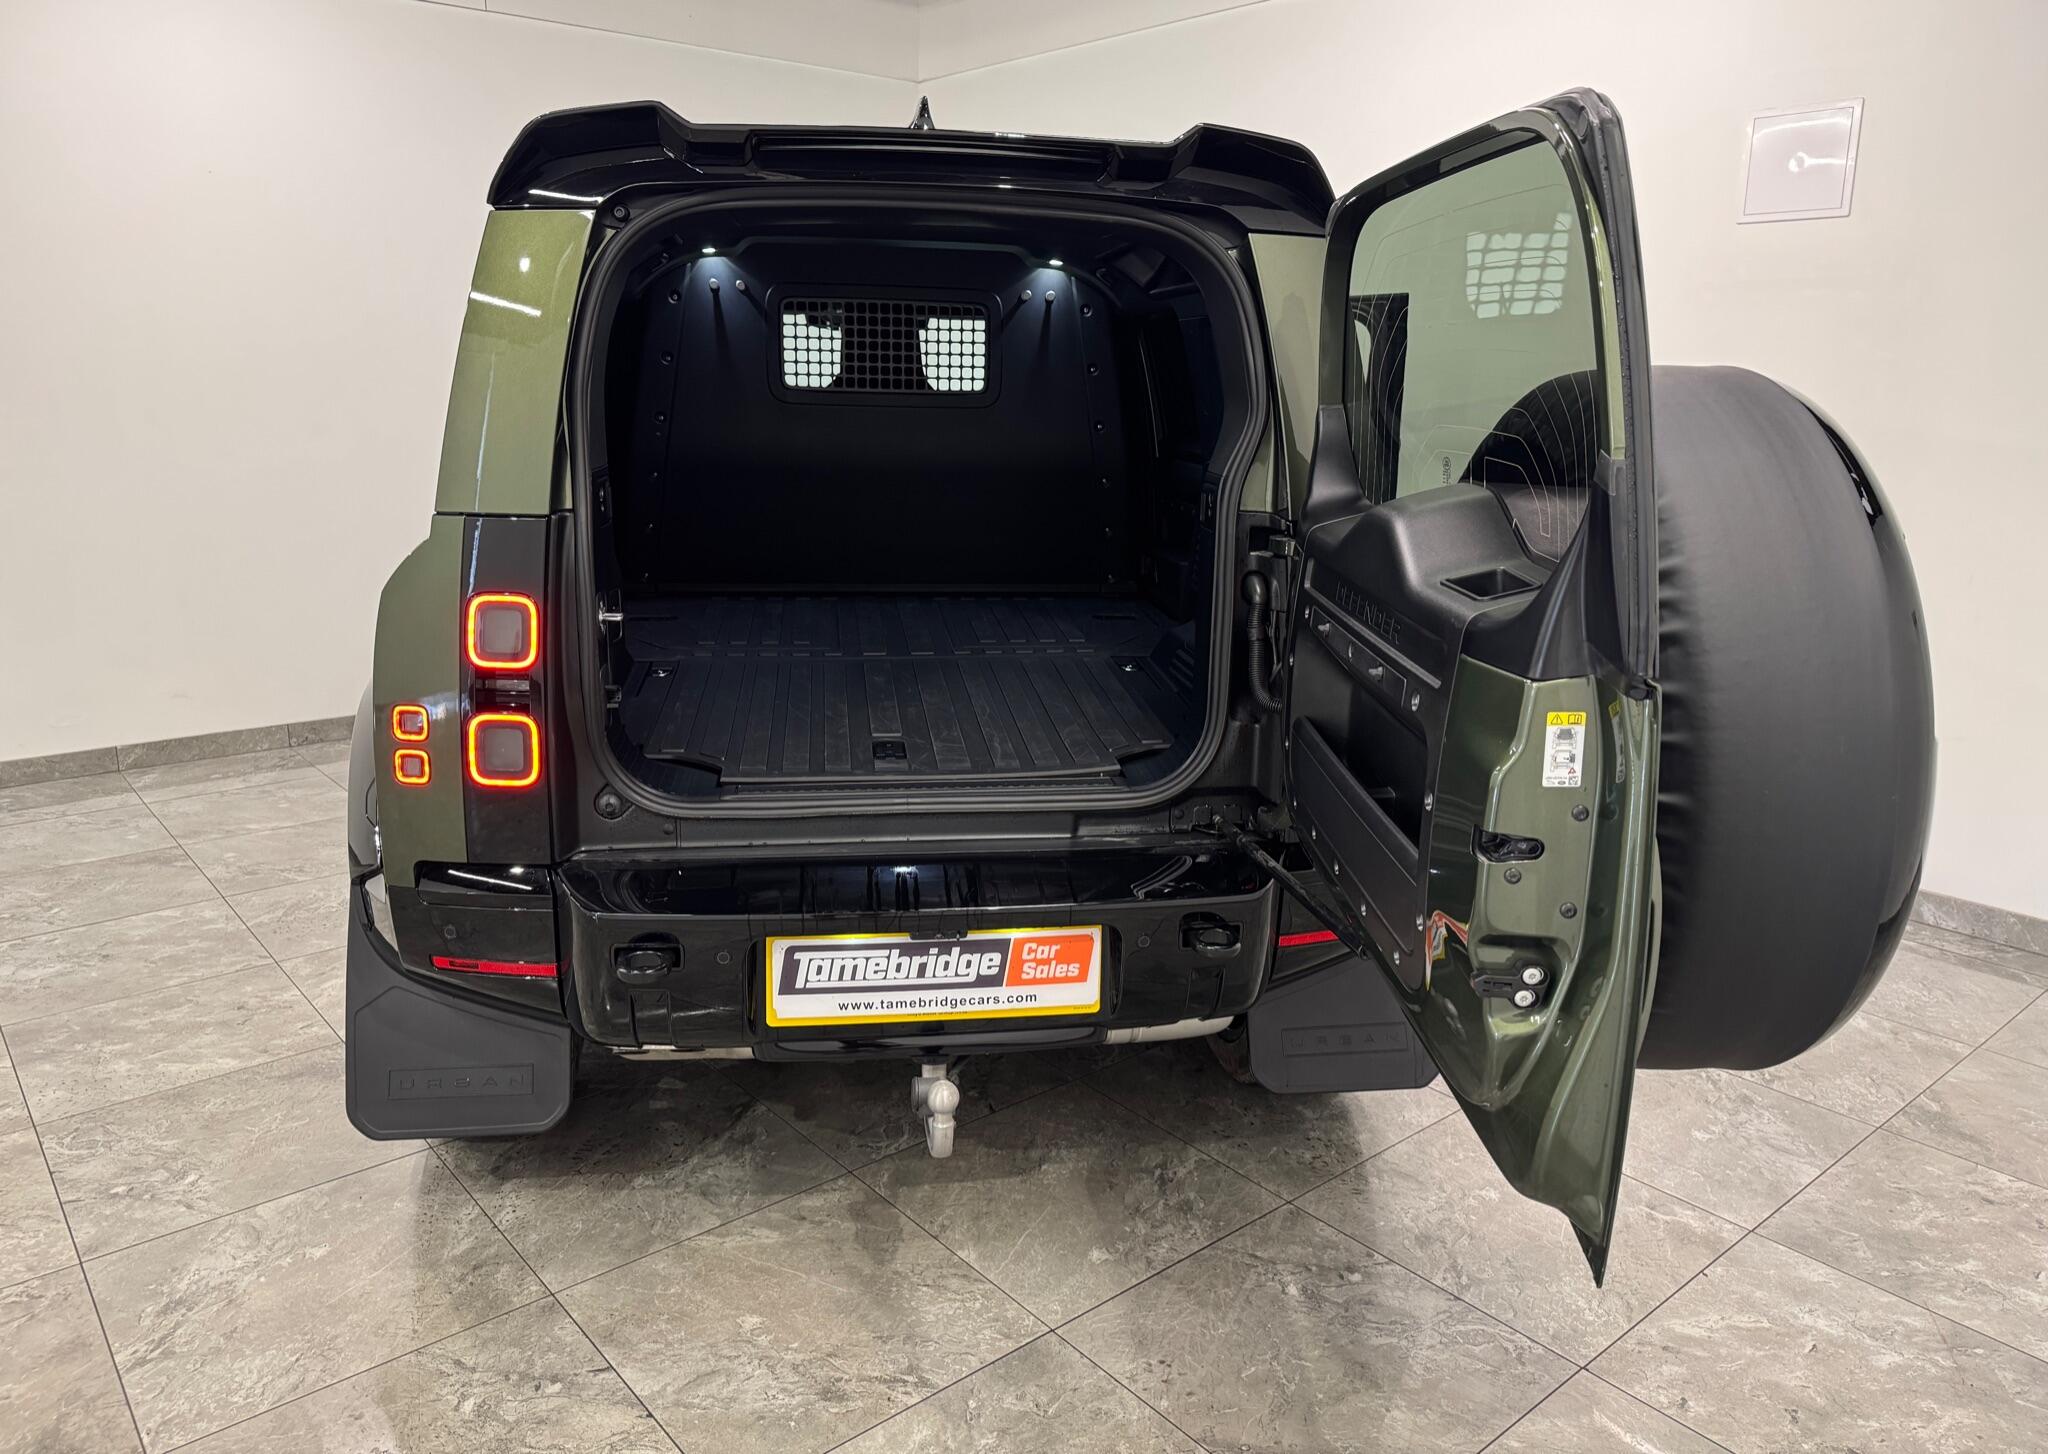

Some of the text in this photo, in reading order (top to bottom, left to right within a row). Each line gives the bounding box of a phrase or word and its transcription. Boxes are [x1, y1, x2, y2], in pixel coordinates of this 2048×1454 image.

[1022, 942, 1062, 960] Car
[794, 947, 1002, 989] Tamebridge
[1021, 961, 1081, 980] Sales
[838, 991, 1038, 1012] www.tamebridgecars.com
[399, 1072, 525, 1090] URBAN
